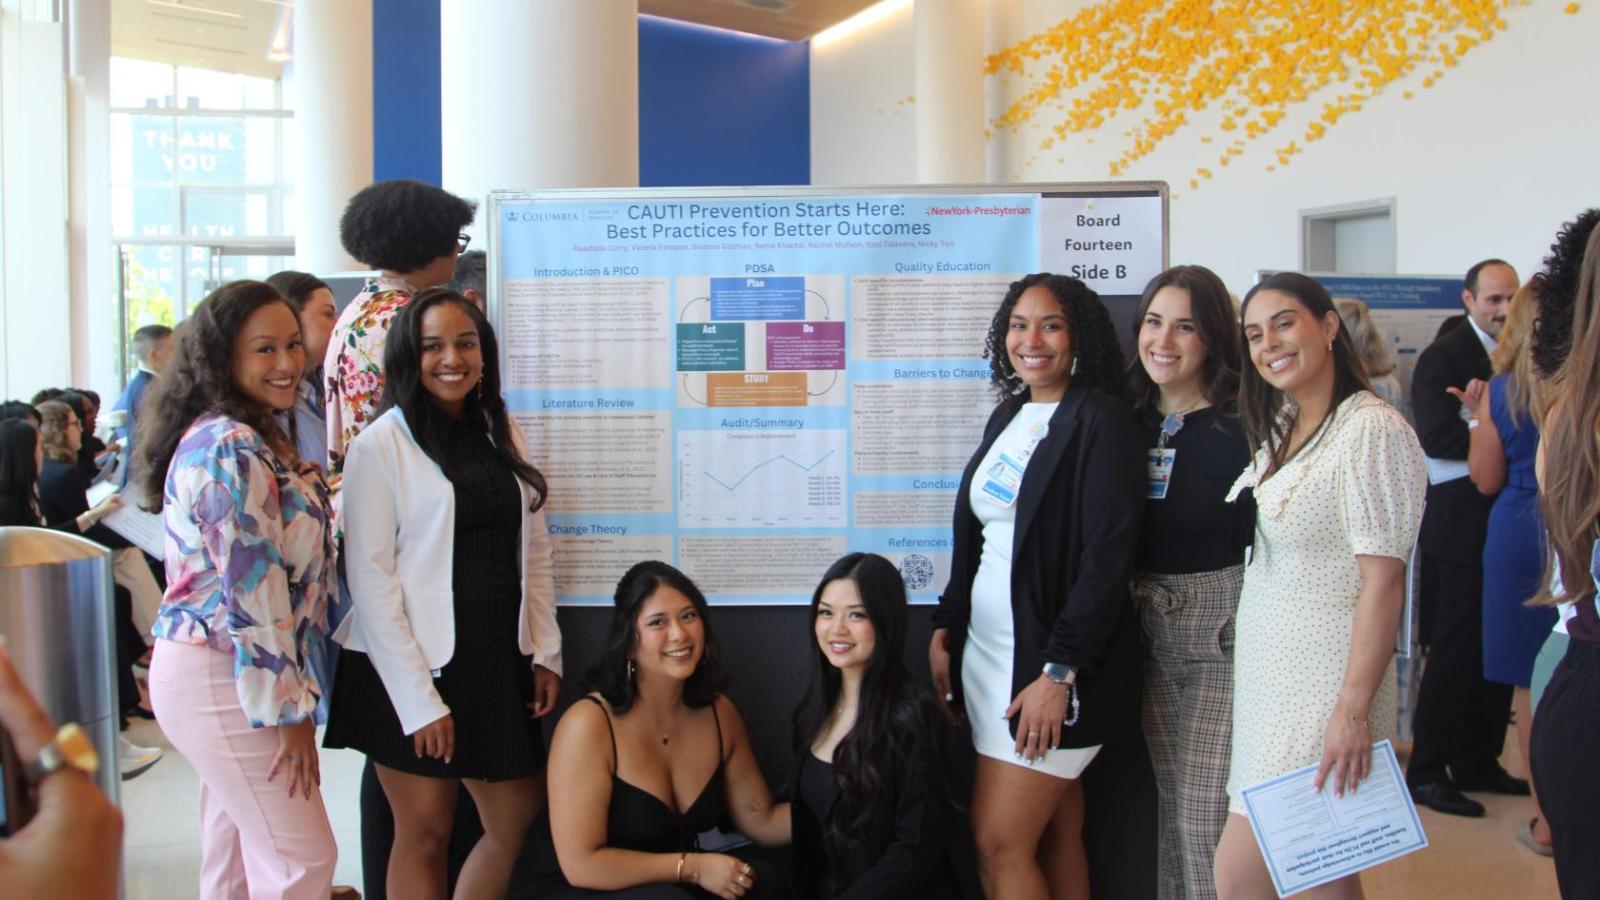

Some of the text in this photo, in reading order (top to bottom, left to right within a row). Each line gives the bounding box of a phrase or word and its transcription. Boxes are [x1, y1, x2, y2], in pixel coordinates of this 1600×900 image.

[142, 131, 235, 149] THANK
[161, 154, 217, 173] YOU
[628, 202, 905, 220] CAUTI Prevention Starts Here:
[931, 206, 1031, 217] NewYork-Presbyterian
[1076, 214, 1120, 227] Board
[607, 220, 931, 239] Best Practices for Better Outcomes
[1065, 239, 1133, 251] Fourteen
[534, 266, 639, 277] Introduction & PICO
[745, 264, 775, 273] PDSA
[895, 261, 991, 273] Quality Education
[1071, 264, 1127, 279] Side B
[747, 279, 765, 288] Plan
[702, 325, 717, 334] Act
[803, 324, 814, 333] Do
[744, 374, 769, 383] STUDY
[894, 368, 936, 378] Barriers
[939, 369, 950, 378] to
[542, 398, 634, 409] Literature Review
[721, 418, 804, 430] Audit/Summary
[913, 479, 960, 489] Conclusi
[548, 524, 627, 536] Change Theory
[888, 538, 948, 547] References
